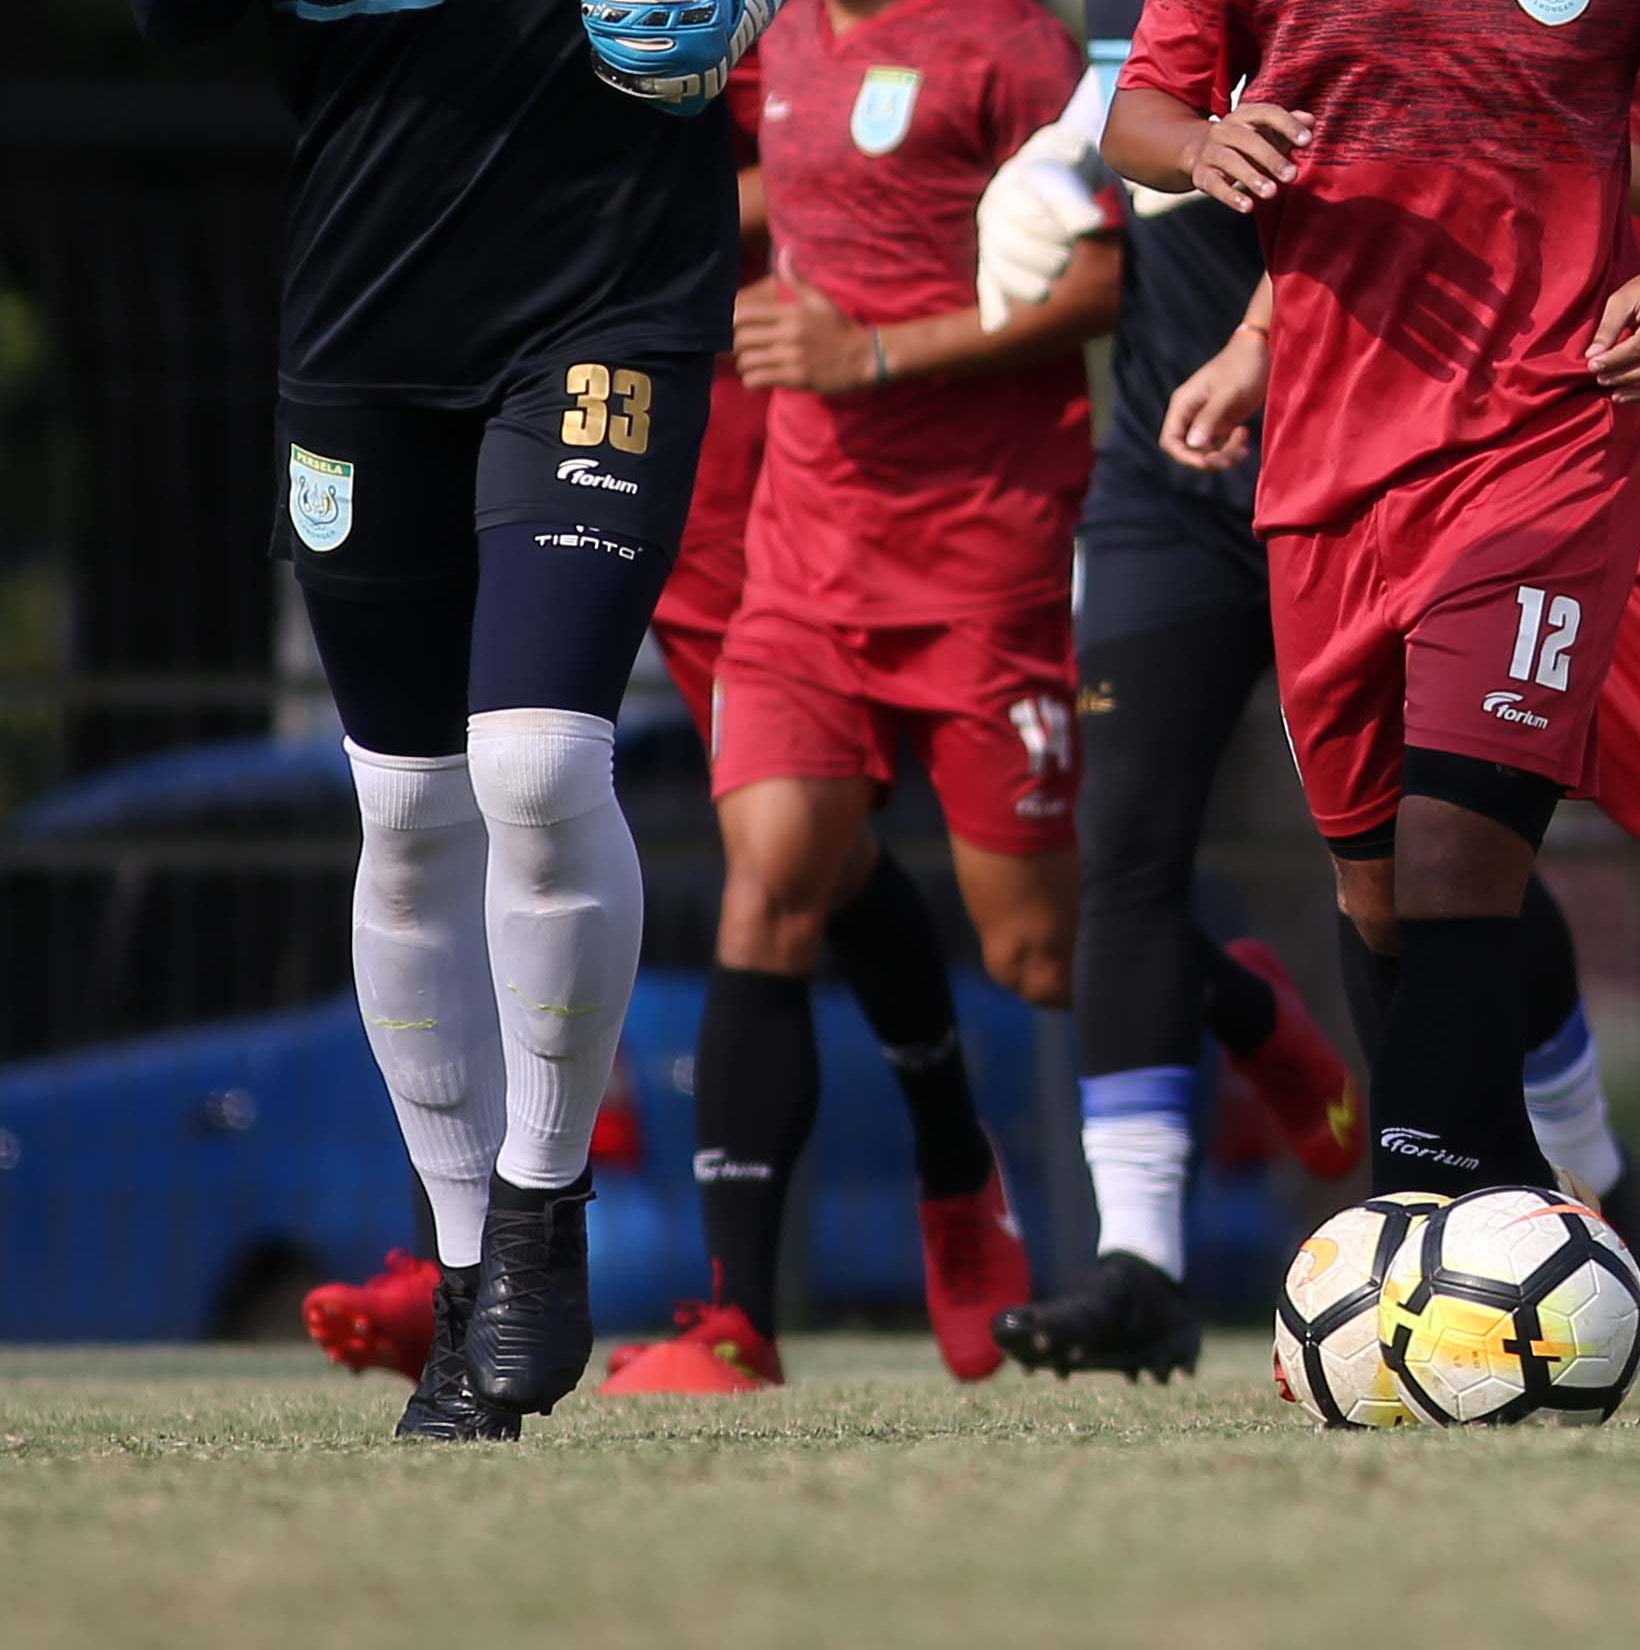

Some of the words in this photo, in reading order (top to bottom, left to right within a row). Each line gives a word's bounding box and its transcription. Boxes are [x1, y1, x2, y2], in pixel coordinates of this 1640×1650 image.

[561, 363, 651, 455] 33
[297, 451, 343, 474] PERSELA
[1508, 585, 1581, 692] 12
